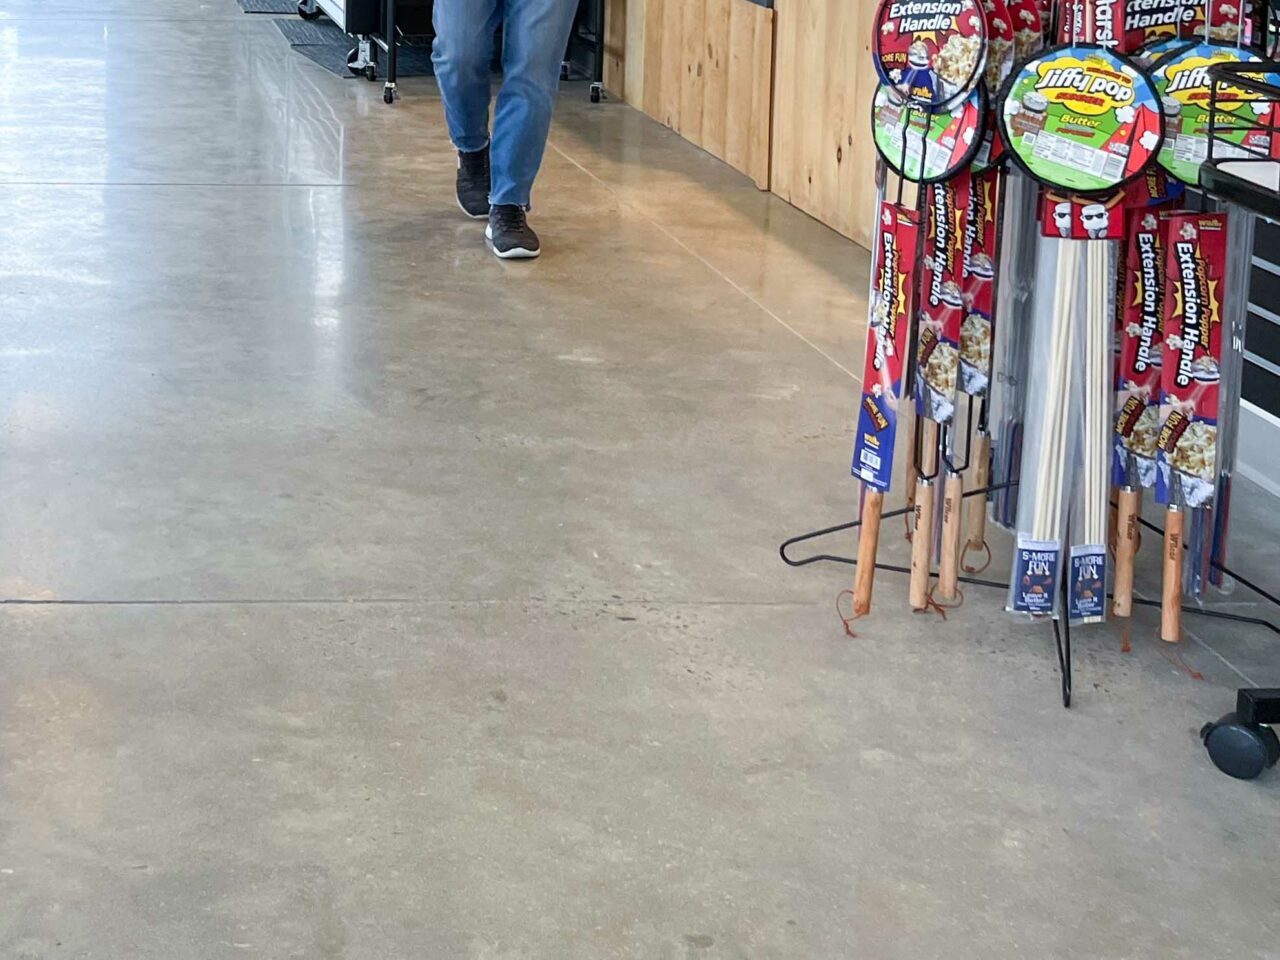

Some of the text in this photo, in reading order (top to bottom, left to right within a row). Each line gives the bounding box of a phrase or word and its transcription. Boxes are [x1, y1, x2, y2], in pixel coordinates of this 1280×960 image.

[889, 1, 961, 19] Extension
[899, 15, 951, 33] Handle
[1124, 9, 1195, 31] Handle
[894, 53, 907, 63] FUN
[1035, 68, 1089, 93] Jiffy
[1089, 77, 1132, 101] pop
[1061, 114, 1102, 128] Butter
[946, 185, 956, 274] Popcorn Popper
[962, 223, 976, 278] Handle
[930, 251, 947, 306] Handle
[873, 231, 895, 370] Extension Handle
[1135, 233, 1157, 372] Extension Handle
[1177, 242, 1200, 386] Extension Handle
[1196, 258, 1210, 351] Popcorn Popper
[864, 397, 889, 429] MORE FUN
[1116, 396, 1139, 434] MORE FUN
[1158, 411, 1182, 449] MORE FUN
[1022, 551, 1056, 562] S-MORE
[1027, 560, 1051, 576] FUN
